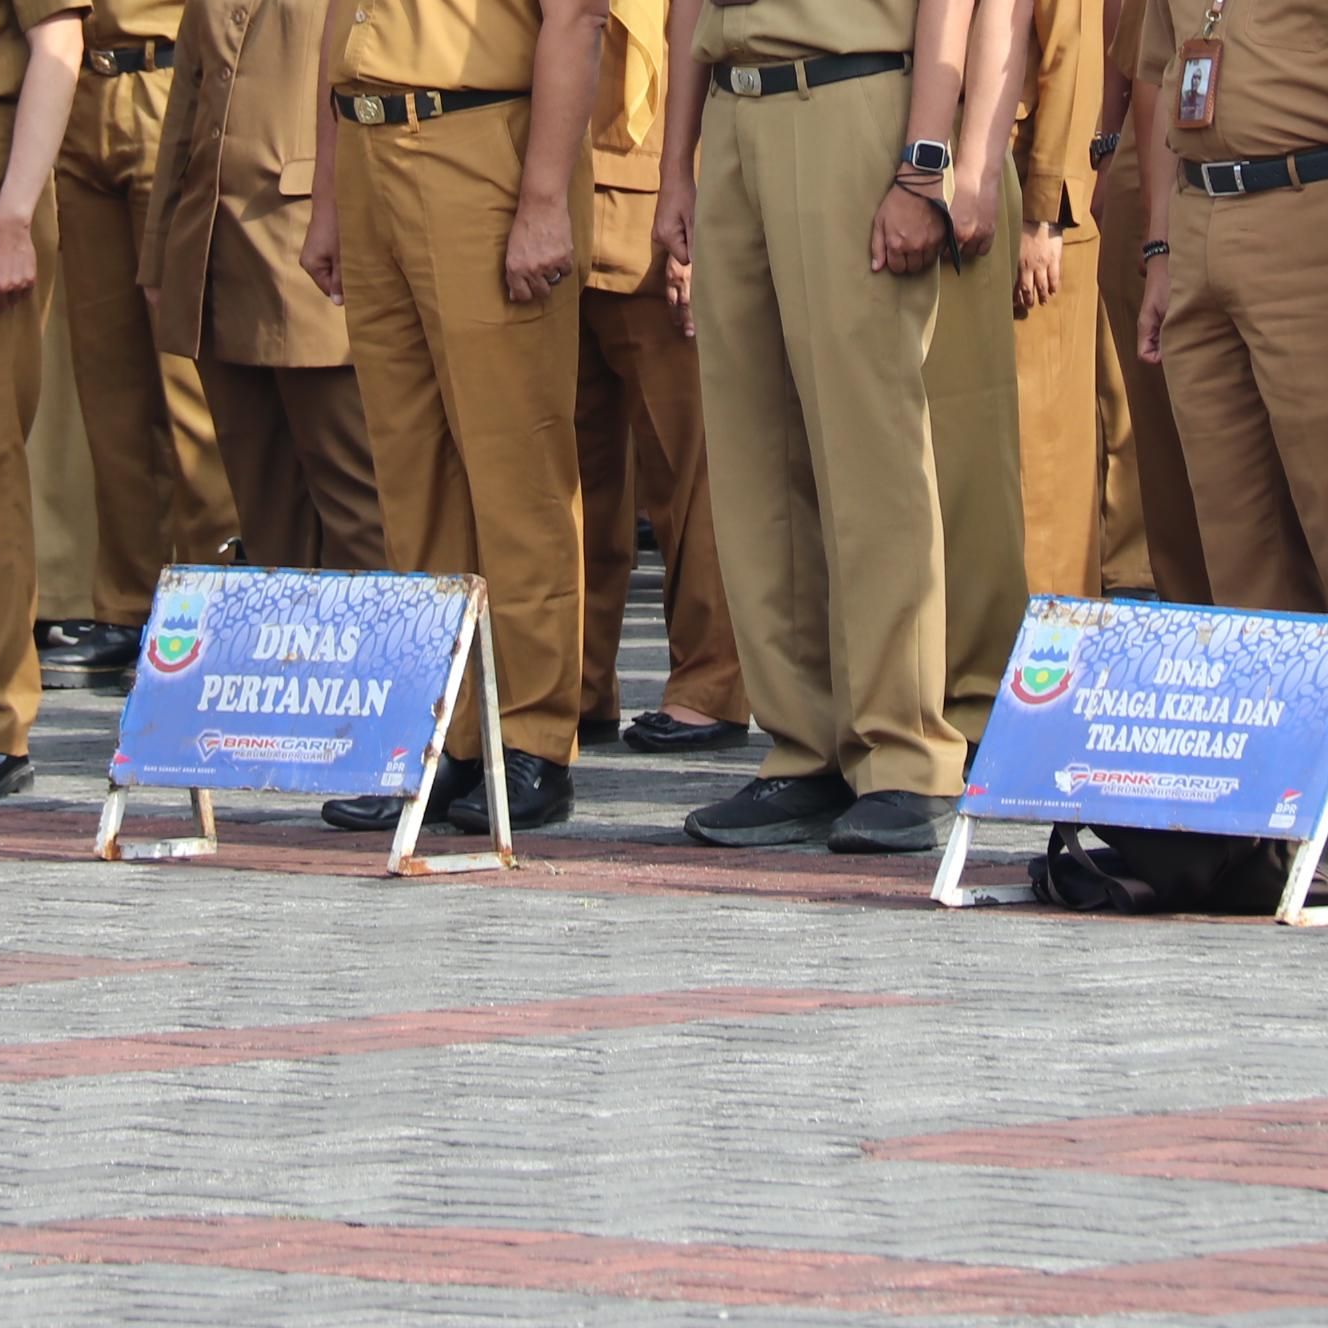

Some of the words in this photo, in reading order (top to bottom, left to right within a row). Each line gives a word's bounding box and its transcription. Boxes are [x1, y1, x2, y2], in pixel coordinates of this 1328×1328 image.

[252, 623, 361, 663] DINAS
[1154, 659, 1225, 688] DINAS
[197, 674, 393, 717] PERTANIAN
[1073, 687, 1157, 720] TENAGA
[1159, 693, 1229, 723] KERJA
[1232, 698, 1286, 727] DAN
[223, 736, 277, 749] BANK
[280, 738, 353, 754] GARUT
[1085, 723, 1249, 760] TRANSMIGRASI
[1092, 772, 1152, 786] BANK
[1157, 776, 1235, 791] GARUT
[1275, 802, 1297, 814] BPR
